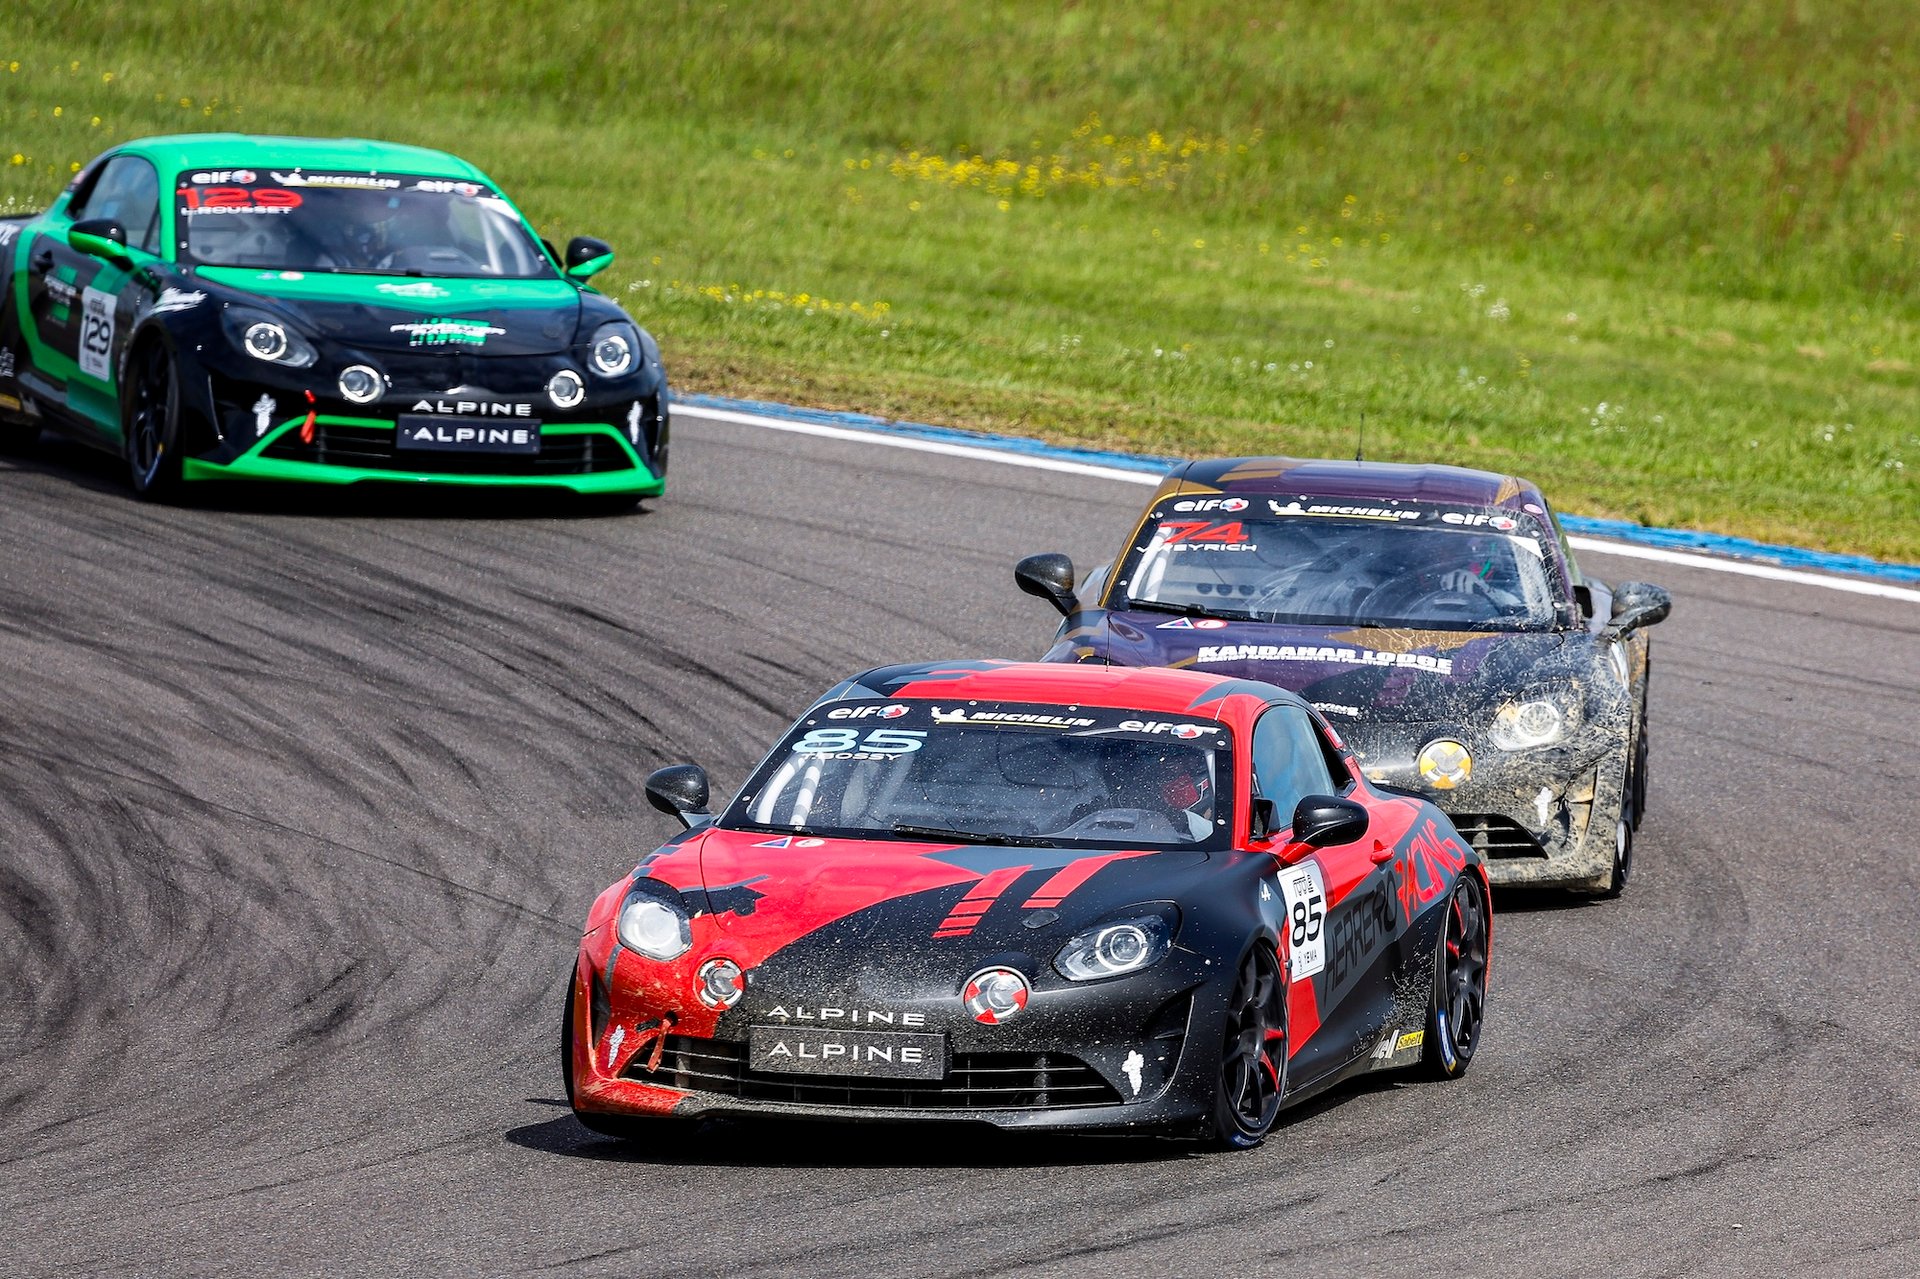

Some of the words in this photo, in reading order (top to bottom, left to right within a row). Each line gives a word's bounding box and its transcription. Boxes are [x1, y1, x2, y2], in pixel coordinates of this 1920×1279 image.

[191, 171, 232, 184] elf
[307, 175, 400, 188] MICHELIN
[417, 180, 456, 192] elf
[176, 187, 303, 209] 129
[83, 314, 111, 356] 129
[412, 399, 531, 416] ALPINE
[413, 426, 530, 444] ALPINE
[1173, 499, 1222, 512] elf
[1307, 505, 1421, 519] MICHELIN
[1441, 512, 1490, 526] elf
[1159, 521, 1249, 544] 74
[1198, 645, 1356, 660] KANDAHAR
[1362, 651, 1453, 668] LODGE
[827, 706, 878, 719] elf
[969, 711, 1096, 727] MICHELIN
[1118, 720, 1173, 734] elf
[792, 729, 928, 753] 85
[1292, 894, 1322, 948] 85
[767, 1005, 926, 1026] ALPINE
[768, 1041, 923, 1063] ALPINE
